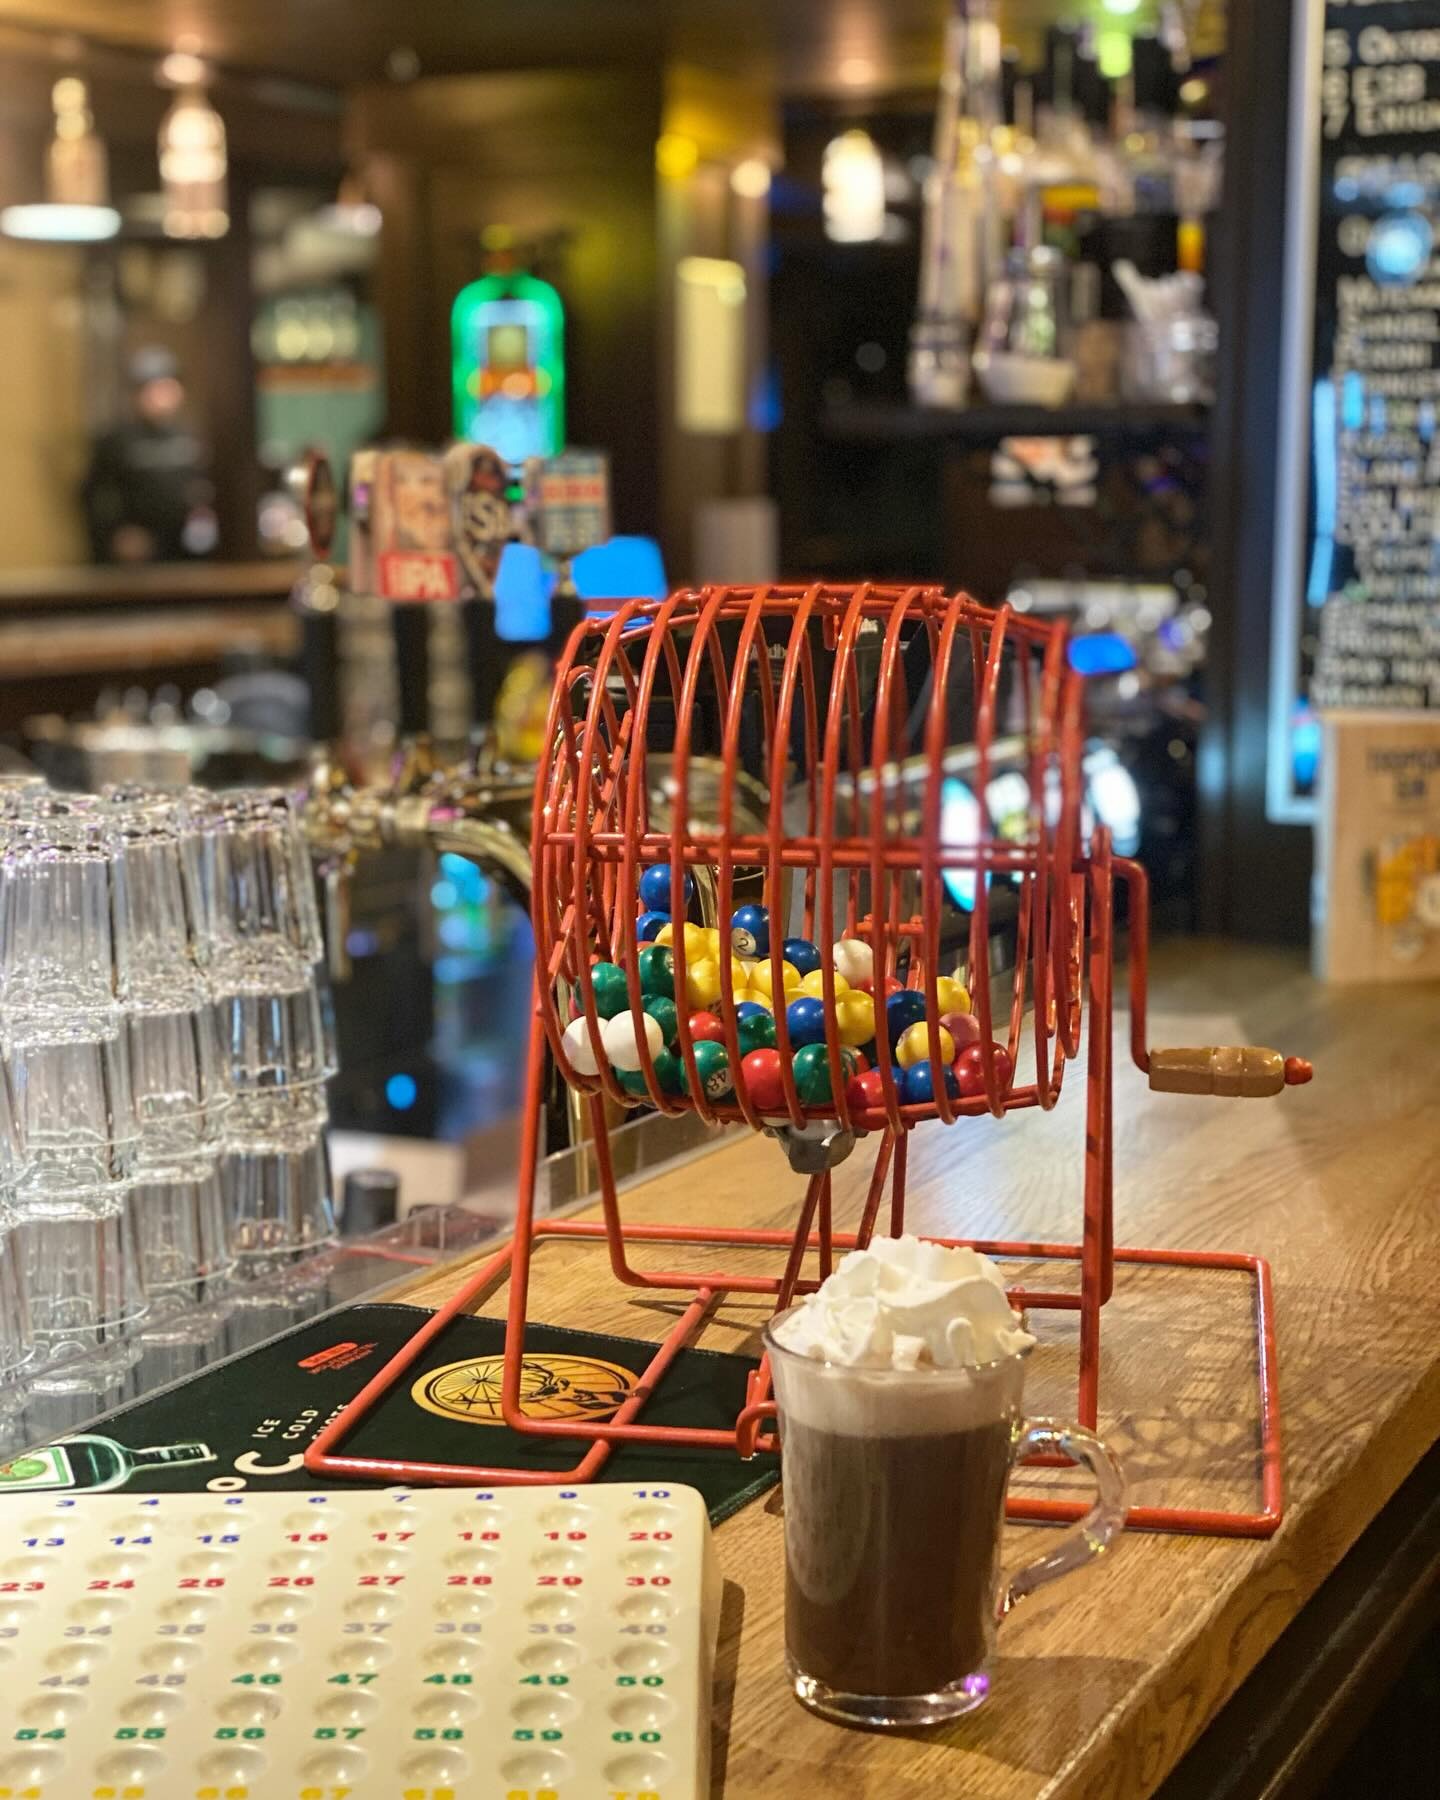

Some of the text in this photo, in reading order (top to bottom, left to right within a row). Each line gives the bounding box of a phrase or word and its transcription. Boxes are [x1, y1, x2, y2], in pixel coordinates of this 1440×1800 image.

[736, 937, 750, 951] 2
[251, 1419, 281, 1438] ICE
[281, 1409, 319, 1439] COLD
[22, 1531, 673, 1548] 13 14 15 16 17 18 19 20
[0, 1575, 672, 1593] 23 24 25 26 27 28 29 30
[63, 1624, 113, 1638] 34
[155, 1623, 207, 1636] 35
[249, 1622, 299, 1635] 36
[343, 1620, 392, 1634] 37
[435, 1621, 482, 1634] 38
[529, 1621, 577, 1635] 39
[618, 1623, 668, 1636] 40
[38, 1673, 665, 1688] 44 45 46 47 48 49 50
[14, 1727, 662, 1744] 54 55 56 57 58 59 60
